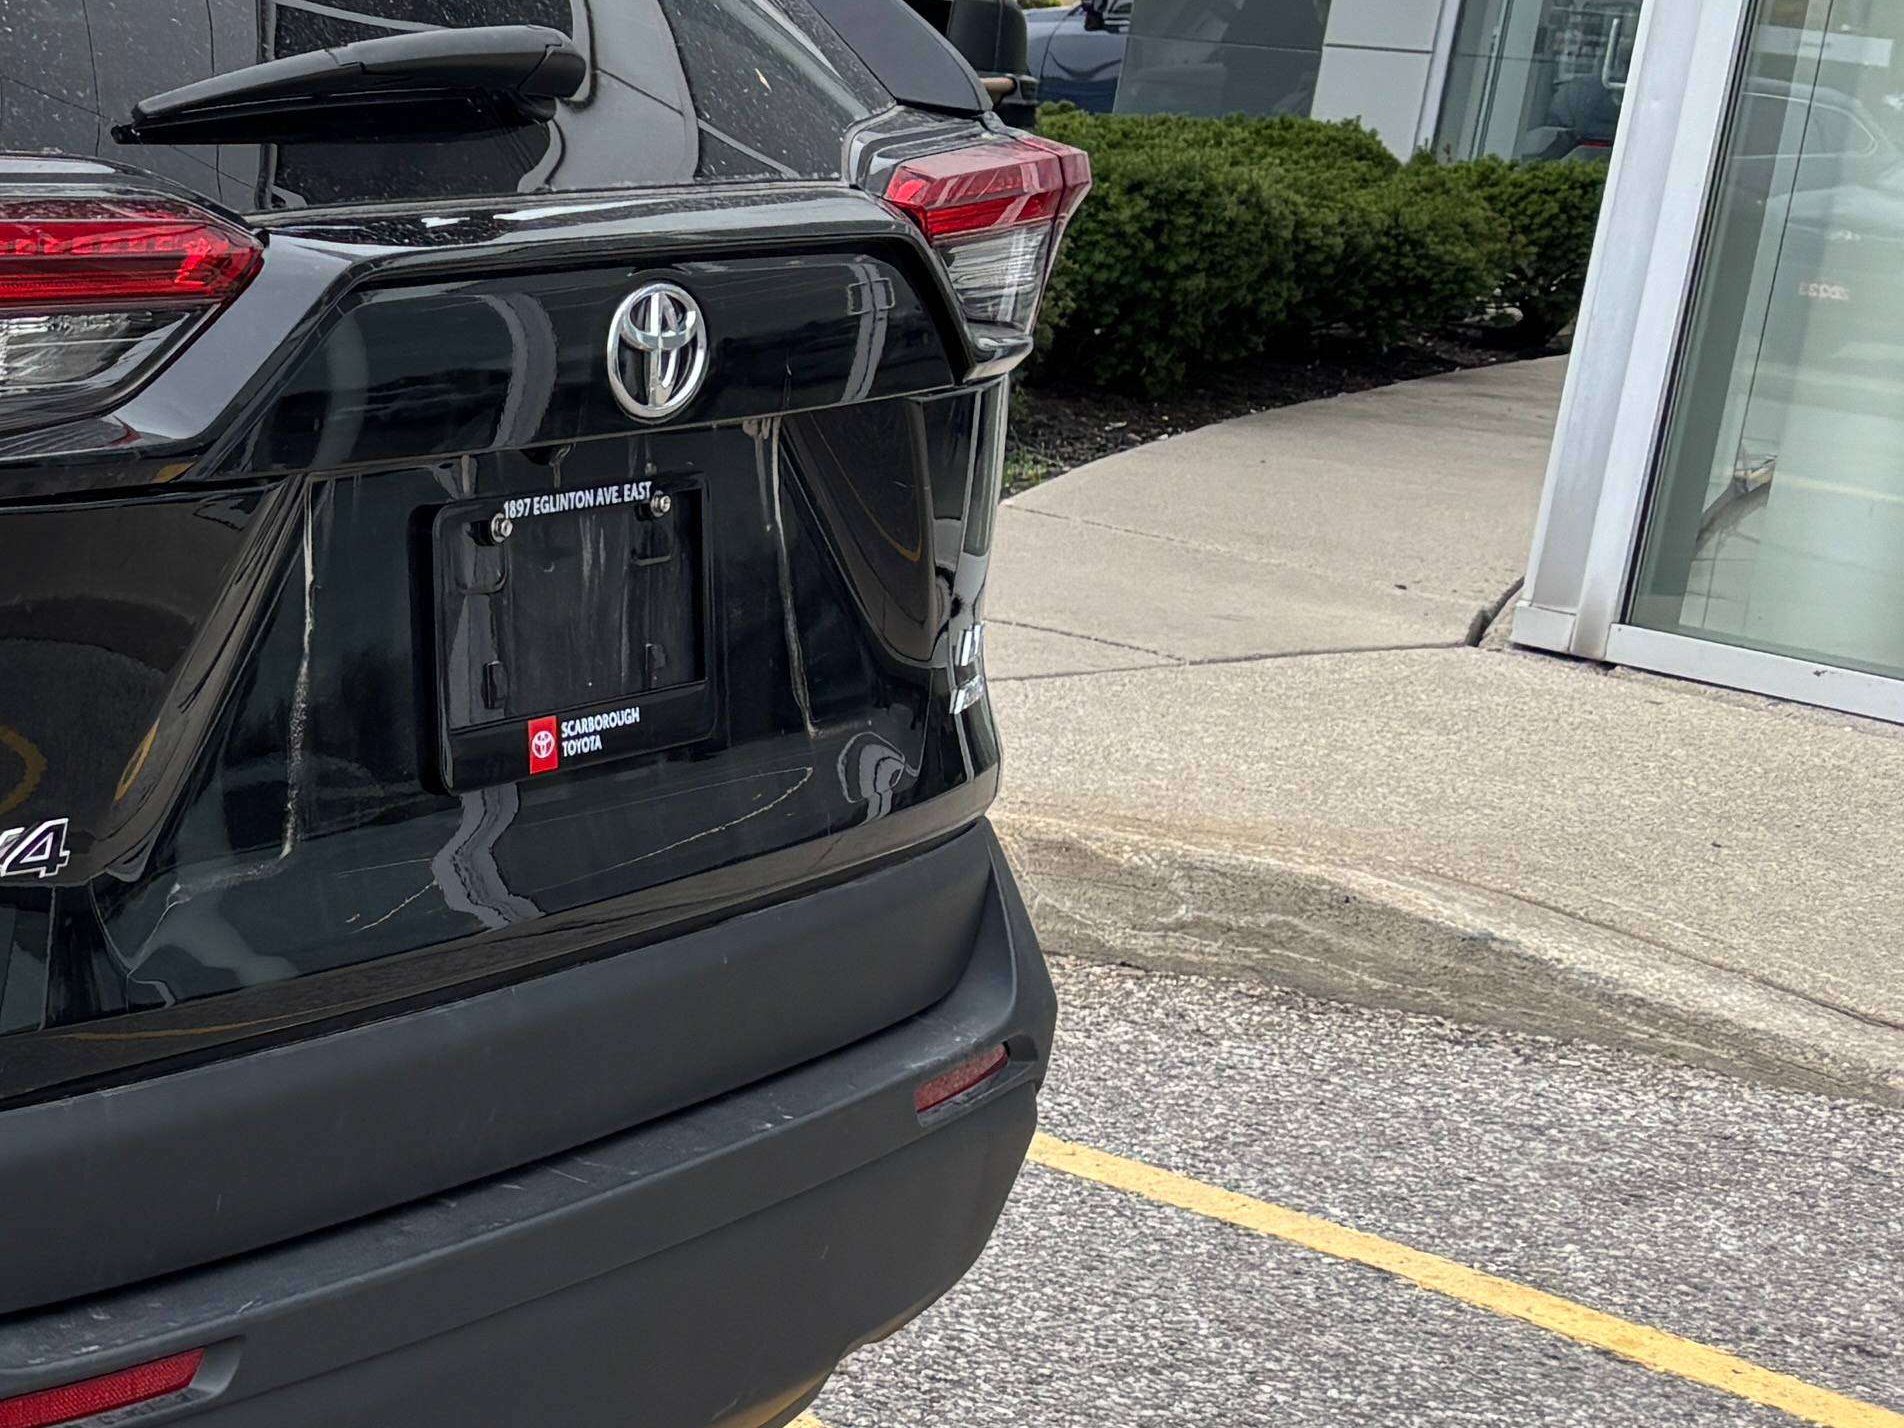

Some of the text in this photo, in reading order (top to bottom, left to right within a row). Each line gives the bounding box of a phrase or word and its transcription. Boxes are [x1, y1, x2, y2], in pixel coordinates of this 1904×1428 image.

[503, 481, 653, 519] 1897 EGLINTON AVE. EAST
[560, 706, 641, 739] SCARBOROUGH
[561, 734, 603, 758] TOYOTA
